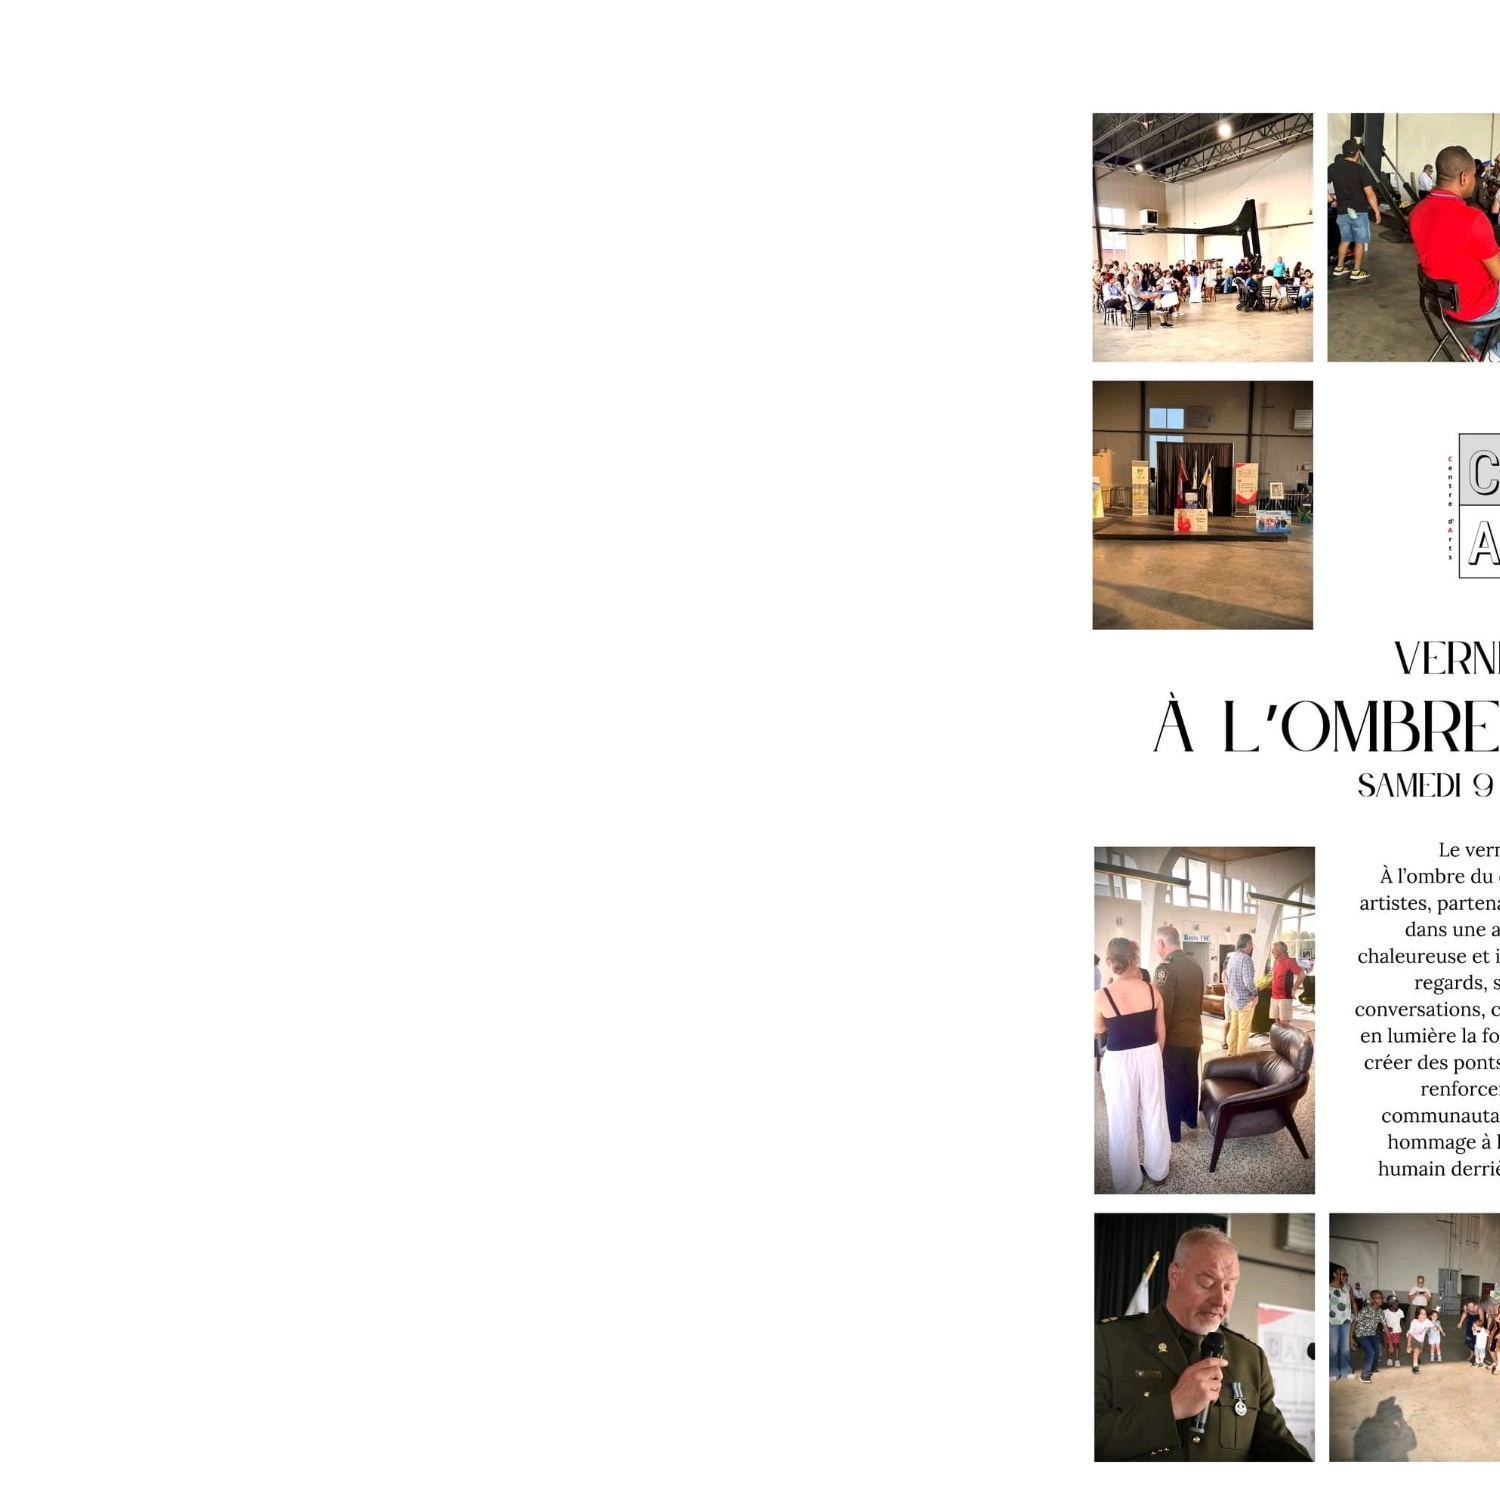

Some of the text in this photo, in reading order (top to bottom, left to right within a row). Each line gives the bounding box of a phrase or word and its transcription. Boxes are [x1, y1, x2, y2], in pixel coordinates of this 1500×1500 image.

[1152, 691, 1195, 753] À
[1357, 772, 1461, 798] SAMEDI
[1472, 772, 1494, 798] 9
[1438, 841, 1461, 858] Le
[1379, 864, 1394, 884] À
[1470, 867, 1494, 885] du
[1359, 894, 1432, 914] artistes,
[1404, 920, 1448, 938] dans
[1452, 925, 1487, 938] une
[1357, 947, 1467, 964] chaleureuse
[1471, 949, 1491, 964] et
[1414, 974, 1488, 996] regards,
[1354, 1001, 1486, 1020] conversations,
[1360, 1031, 1383, 1044] en
[1387, 1026, 1457, 1044] lumière
[1461, 1026, 1477, 1044] la
[1363, 1053, 1413, 1071] créer
[1417, 1053, 1449, 1071] des
[1387, 1133, 1477, 1155] hommage
[1481, 1132, 1492, 1150] à
[1377, 1160, 1446, 1177] humain
